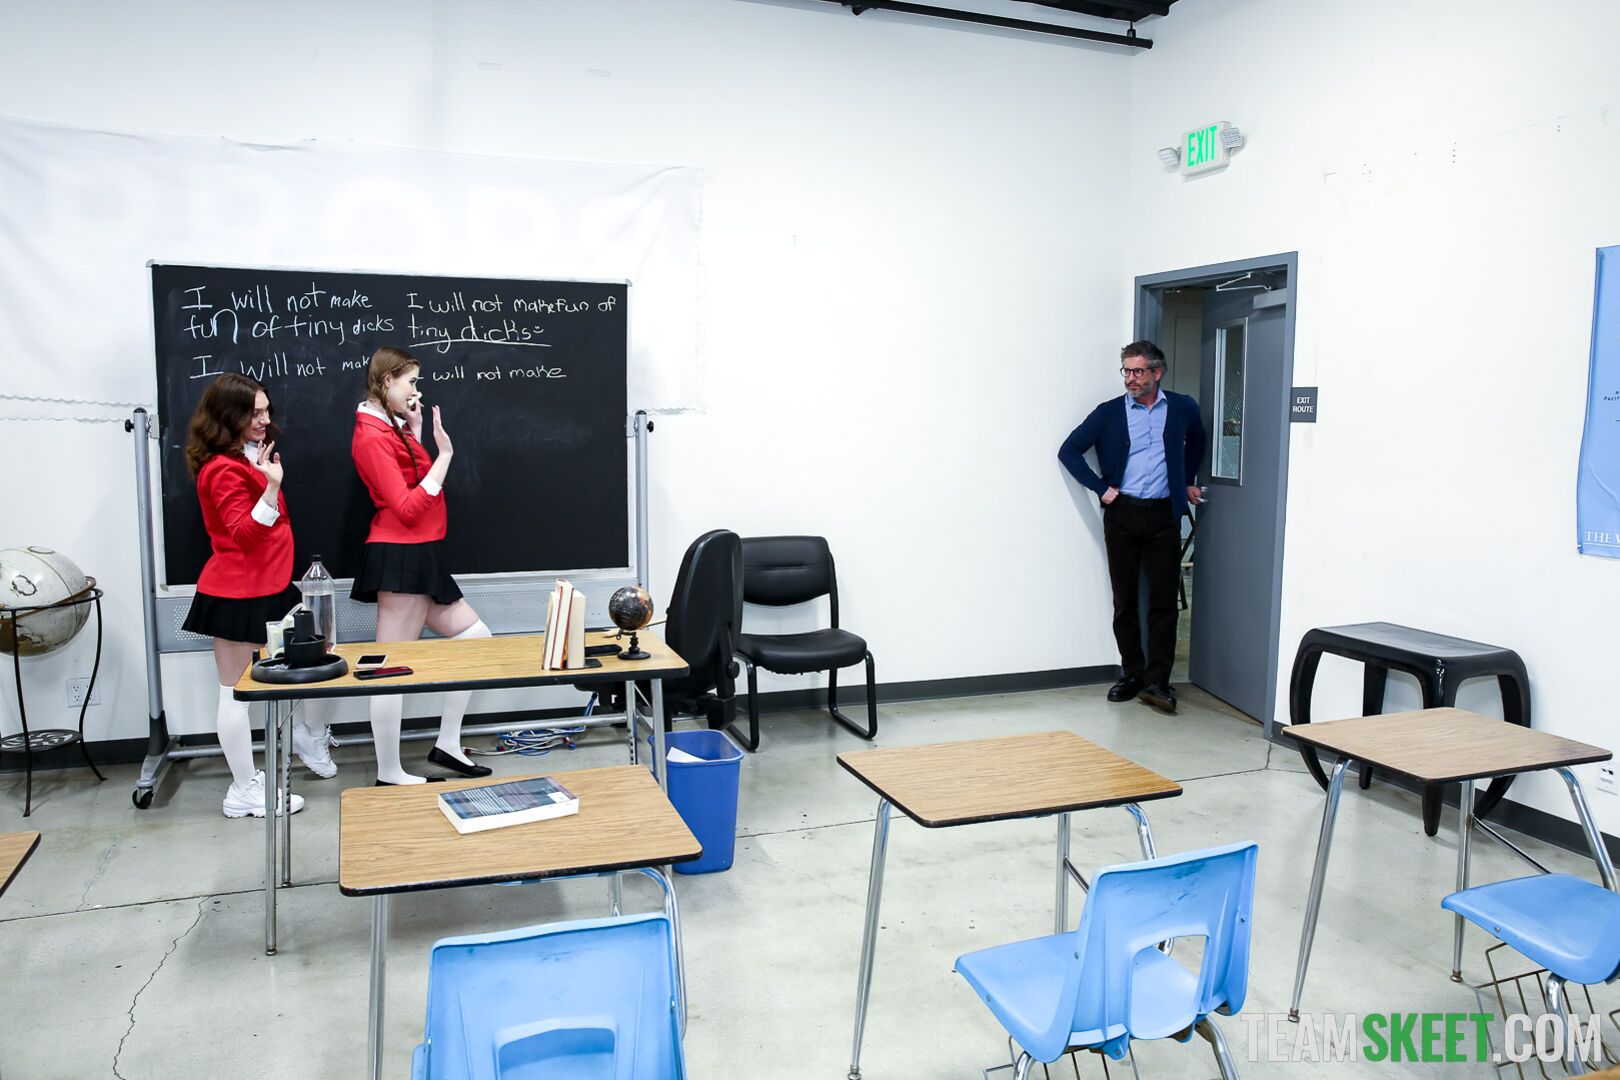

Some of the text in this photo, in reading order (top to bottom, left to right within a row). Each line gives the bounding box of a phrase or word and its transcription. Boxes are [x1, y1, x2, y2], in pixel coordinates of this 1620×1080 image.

[1187, 125, 1217, 167] EXIT
[181, 282, 373, 313] I will not make
[406, 292, 423, 309] I
[429, 292, 465, 313] will
[471, 294, 503, 312] not
[597, 296, 616, 312] of
[184, 308, 395, 345] fun of tiny dicks
[407, 313, 532, 353] tiny dicks
[189, 354, 224, 379] I
[297, 357, 326, 376] not
[342, 355, 370, 371] mak
[432, 365, 567, 380] will not make
[1292, 405, 1315, 413] ROUTE
[1296, 396, 1311, 404] EXIT
[1585, 530, 1611, 543] THE
